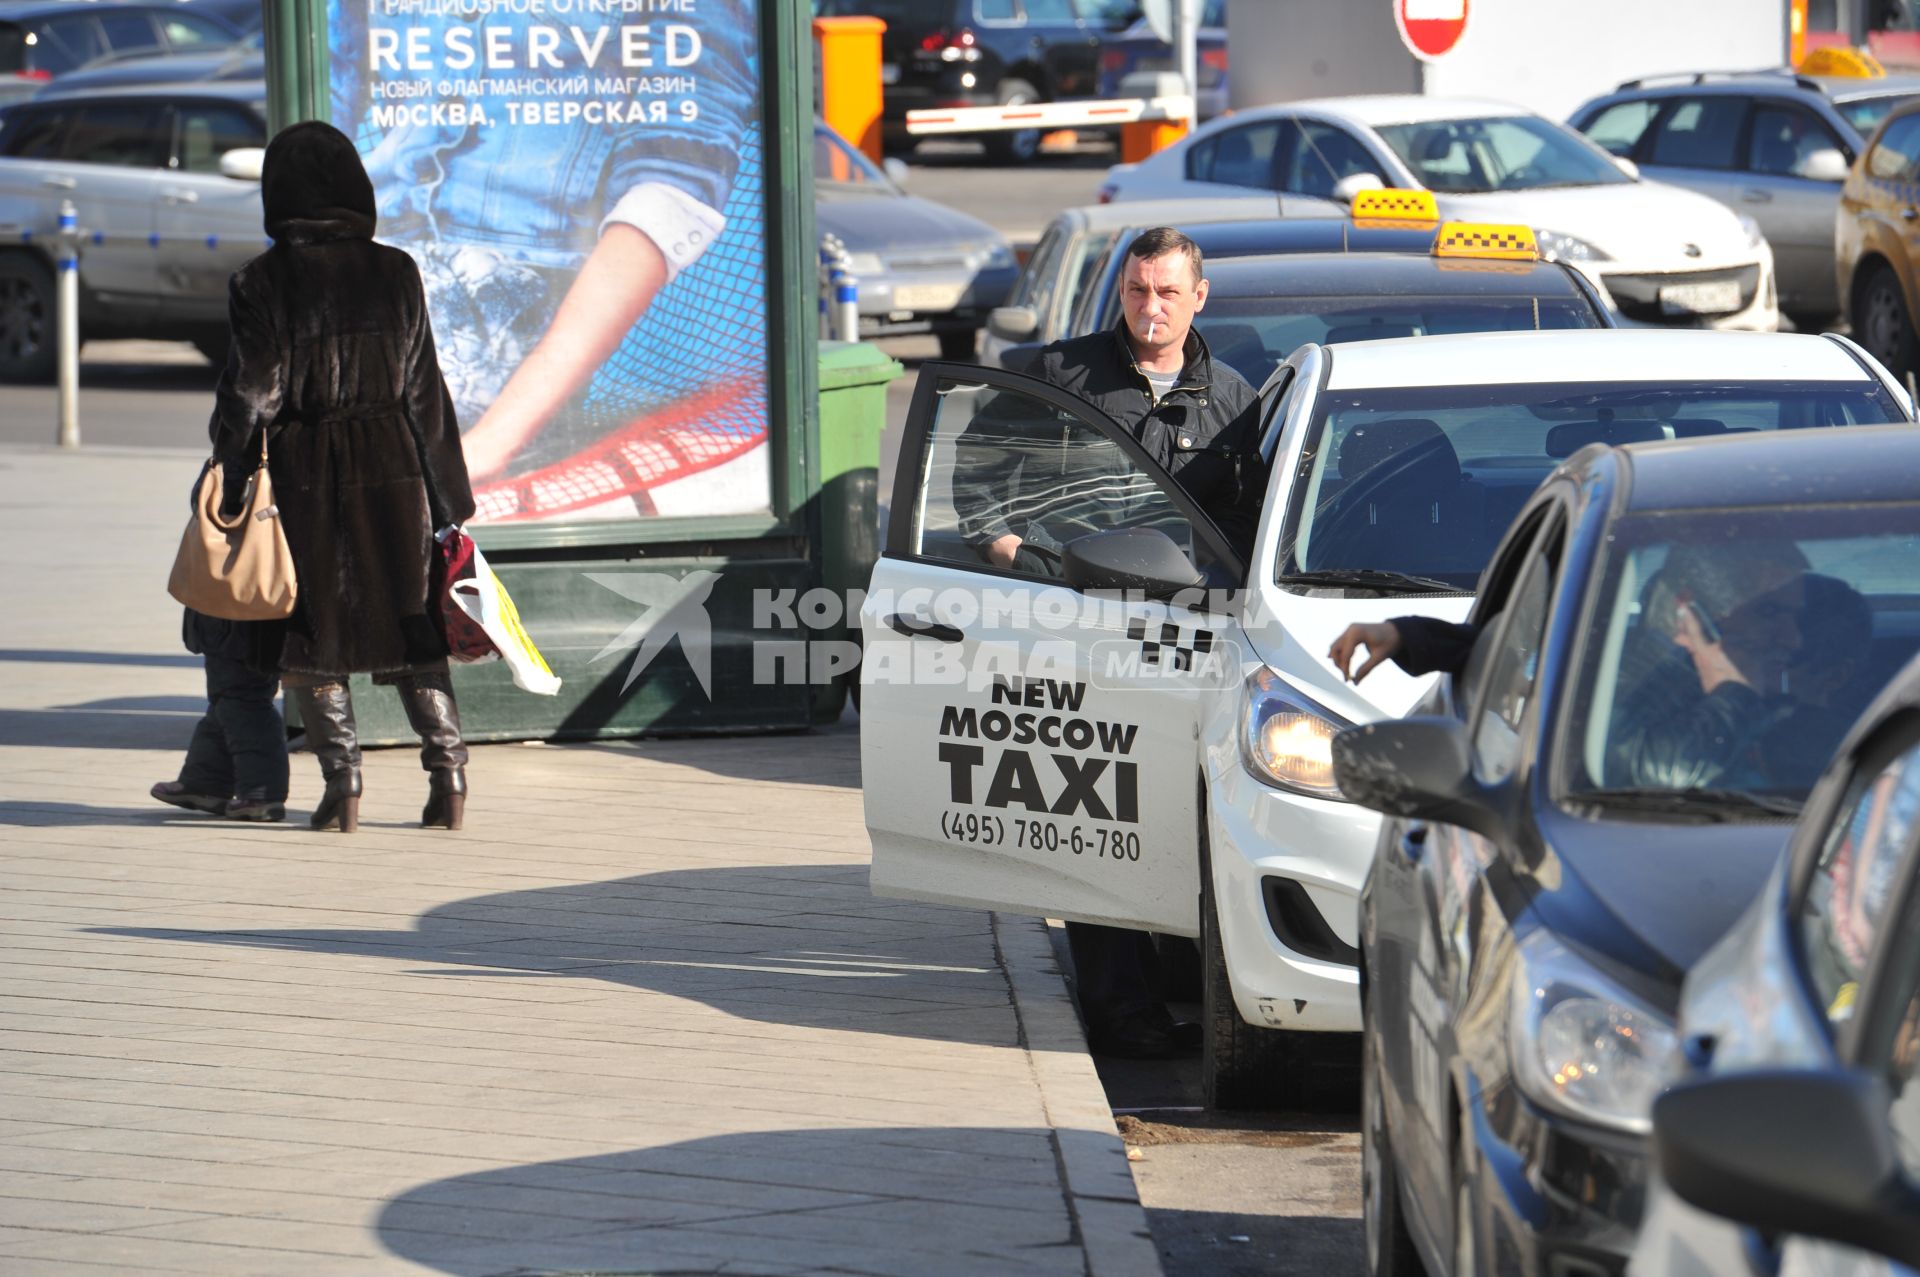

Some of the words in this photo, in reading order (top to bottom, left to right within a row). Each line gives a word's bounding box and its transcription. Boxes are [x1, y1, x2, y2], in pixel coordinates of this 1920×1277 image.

[368, 0, 545, 16] ГРАНДИОЗНОЕ
[552, 0, 696, 13] ОТКРЫТИЕ
[368, 25, 702, 71] RESERVED
[370, 78, 432, 98] НОВЫЙ
[437, 76, 588, 97] ФЛАГМАНСКИЙ
[594, 77, 696, 95] МАГАЗИН
[371, 103, 496, 128] МОСКВА,
[505, 101, 668, 126] ТВЕРСКАЯ
[680, 100, 698, 122] 9
[992, 673, 1087, 712] NEW
[939, 705, 1139, 755] MOSCOW
[938, 741, 1139, 824] TAXI
[941, 810, 1004, 846] (495)
[1014, 819, 1141, 862] 780-6-780
